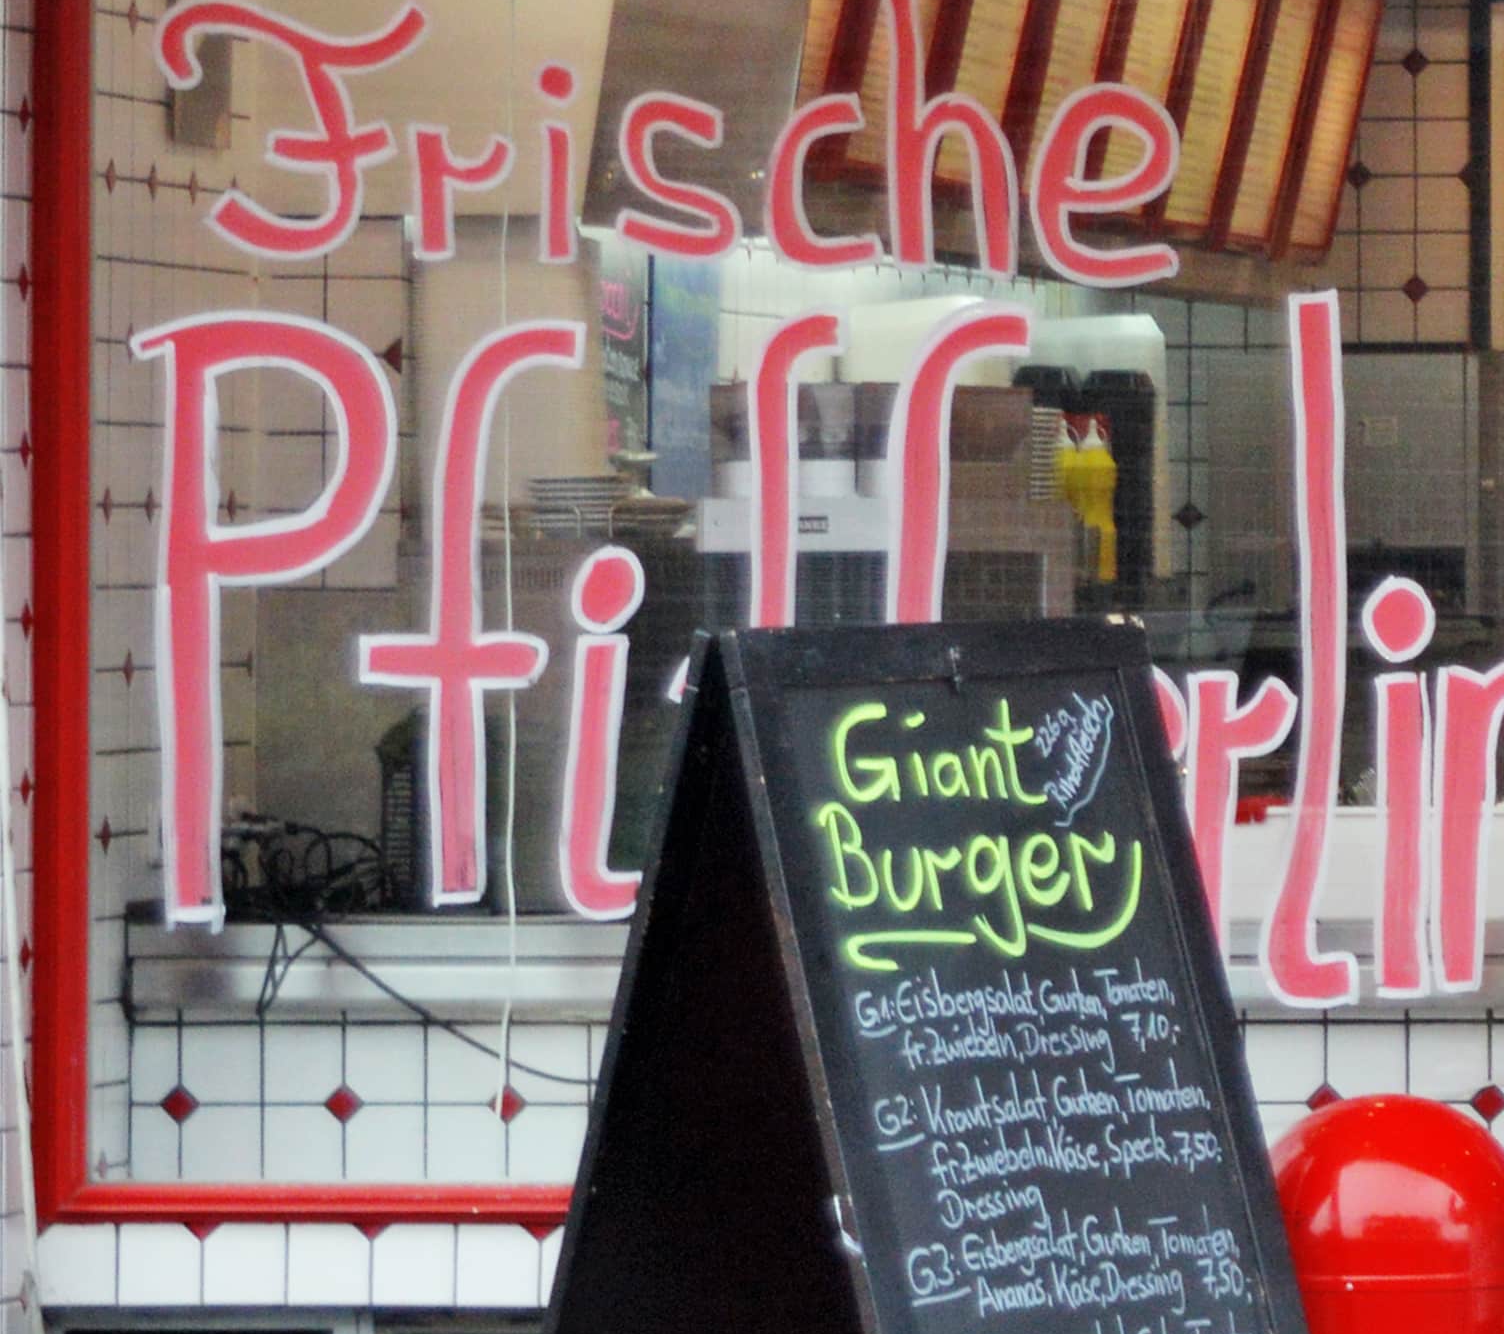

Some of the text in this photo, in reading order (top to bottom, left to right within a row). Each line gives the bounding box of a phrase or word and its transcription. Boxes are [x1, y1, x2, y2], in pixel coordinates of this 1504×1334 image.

[834, 698, 1049, 805] Giant
[817, 800, 1118, 958] Burger
[936, 1180, 1050, 1230] Dressing
